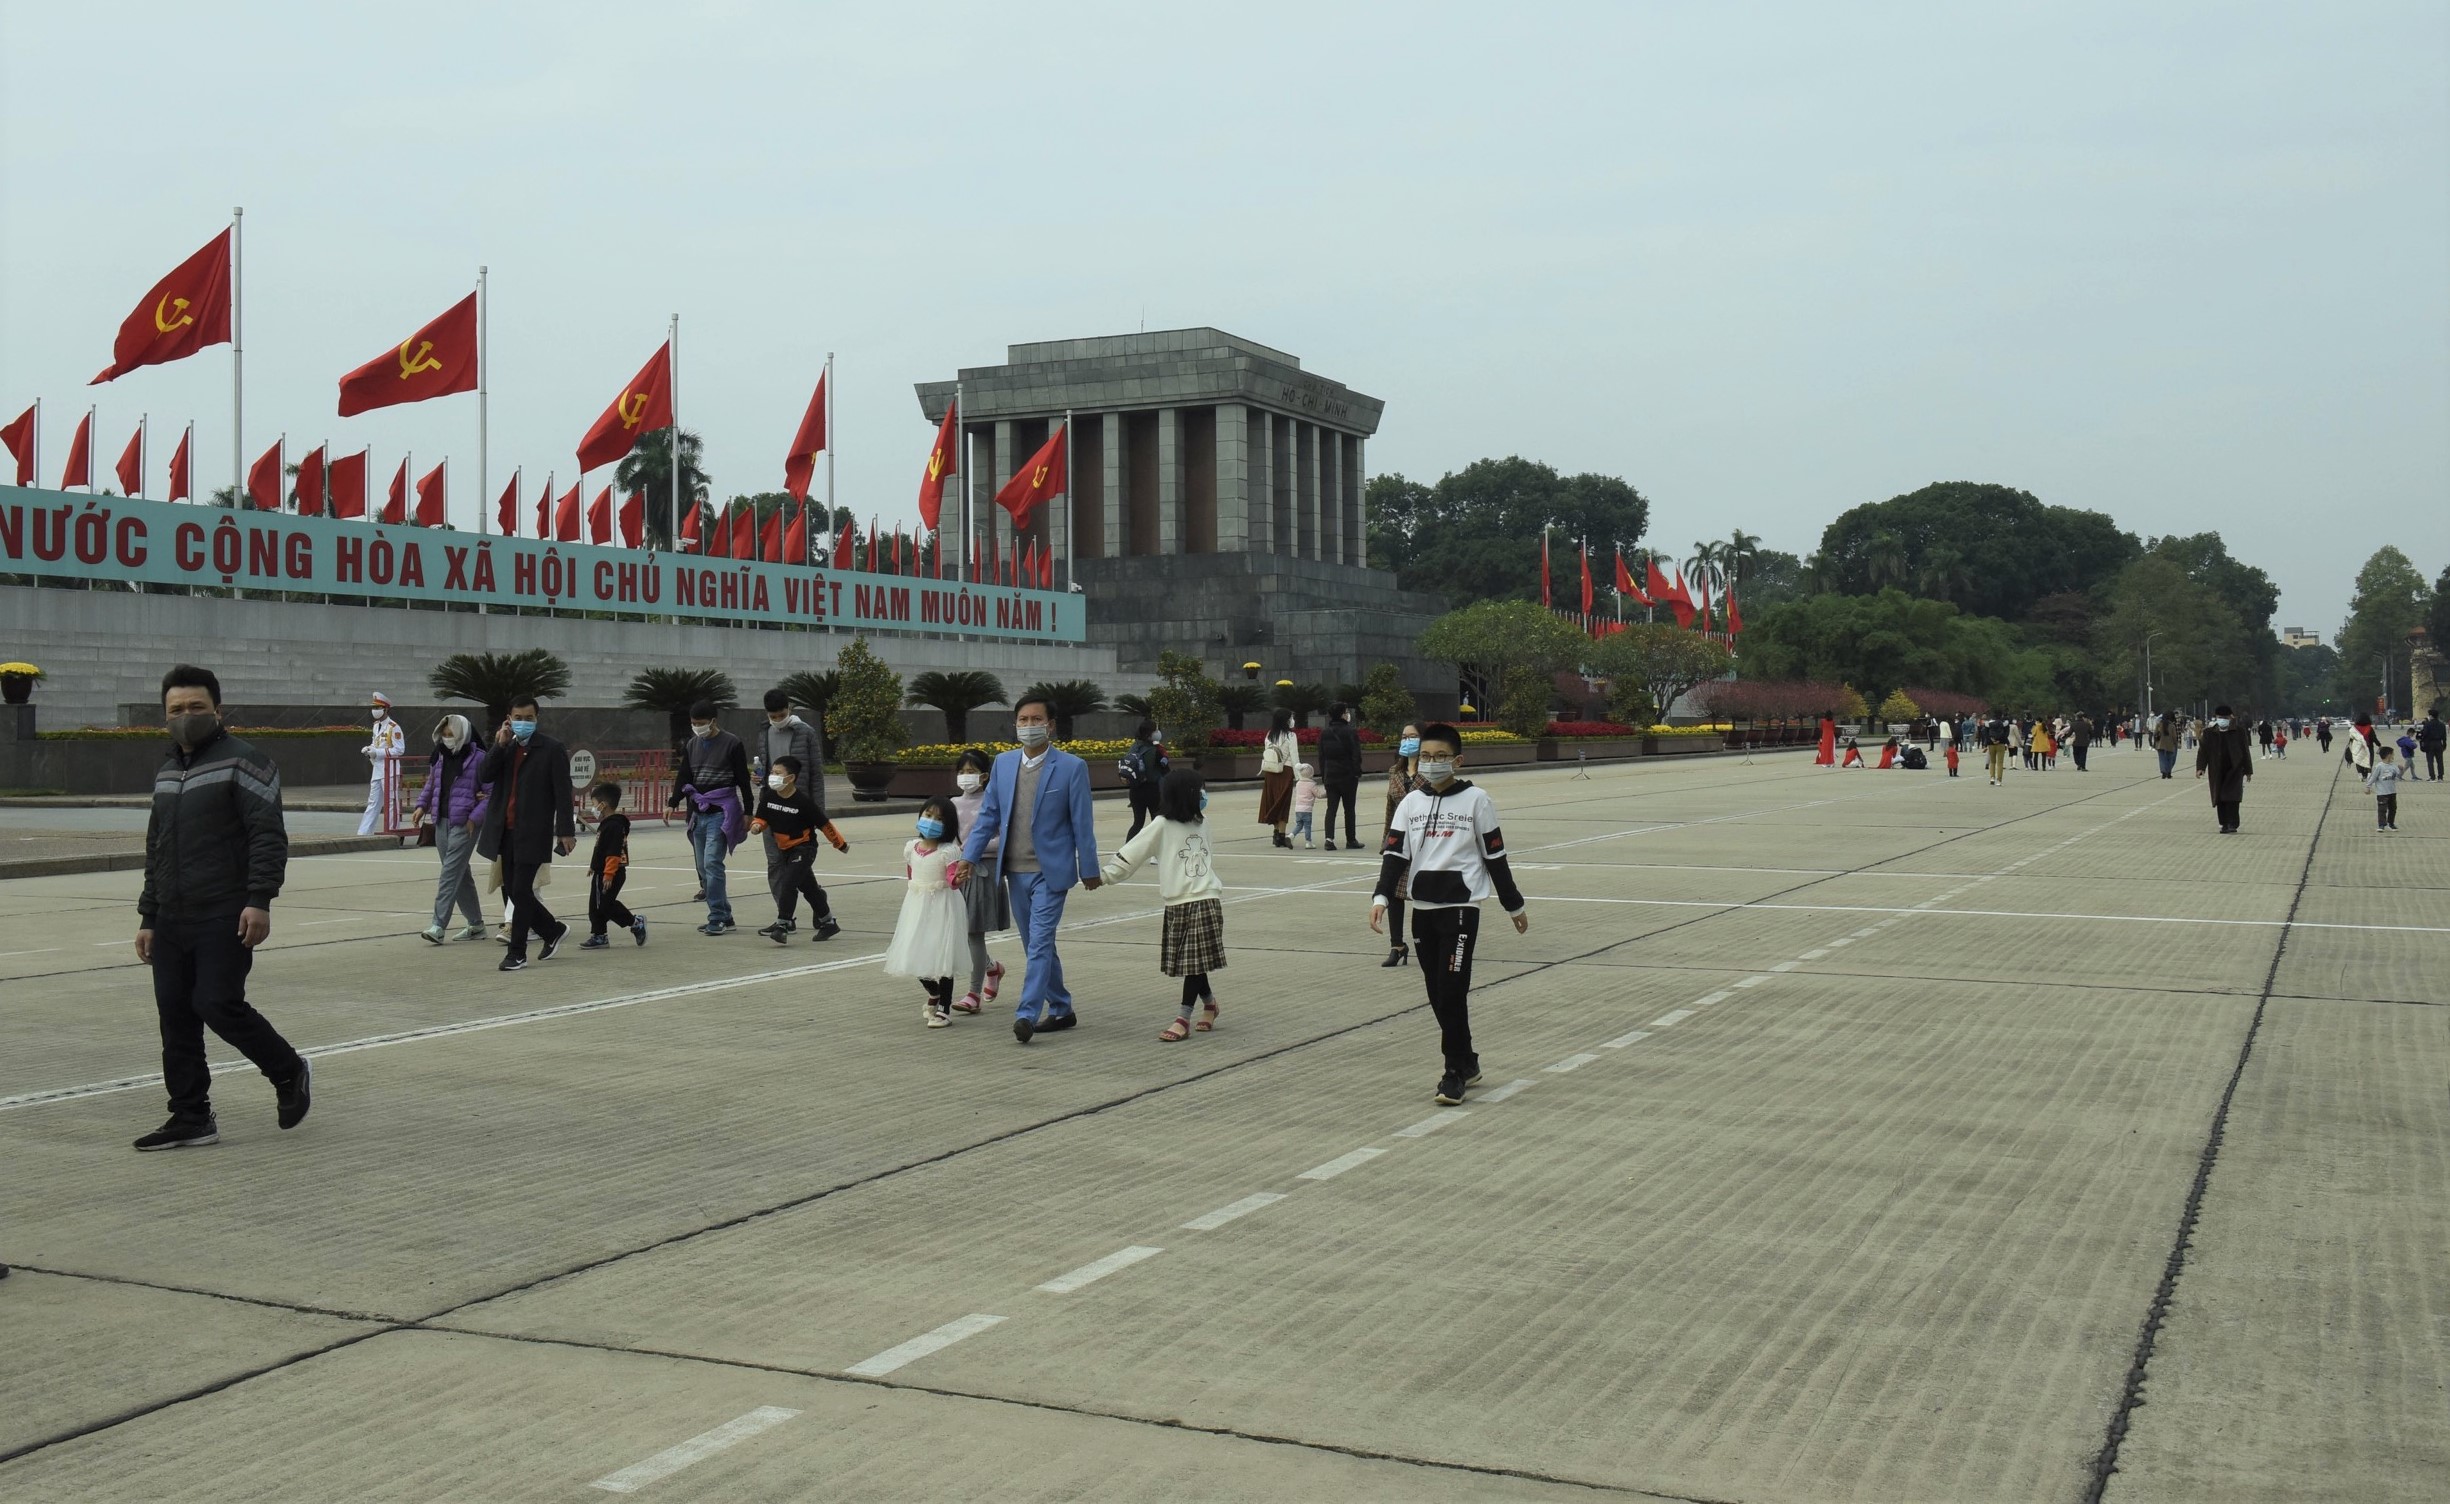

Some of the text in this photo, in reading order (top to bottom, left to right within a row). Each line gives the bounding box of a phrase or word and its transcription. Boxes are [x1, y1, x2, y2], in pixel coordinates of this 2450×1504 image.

[0, 501, 147, 567] NƯỚC
[175, 515, 312, 583] CỘNG
[336, 530, 425, 587] HÒA
[445, 541, 497, 593] XÃ
[514, 547, 576, 605] HỘI
[593, 553, 660, 604] CHỦ
[676, 566, 770, 612] NGHĨA
[784, 573, 842, 623] VIỆT
[855, 585, 910, 621] NAM
[921, 589, 987, 628] MUÔN
[997, 592, 1042, 632] NĂM
